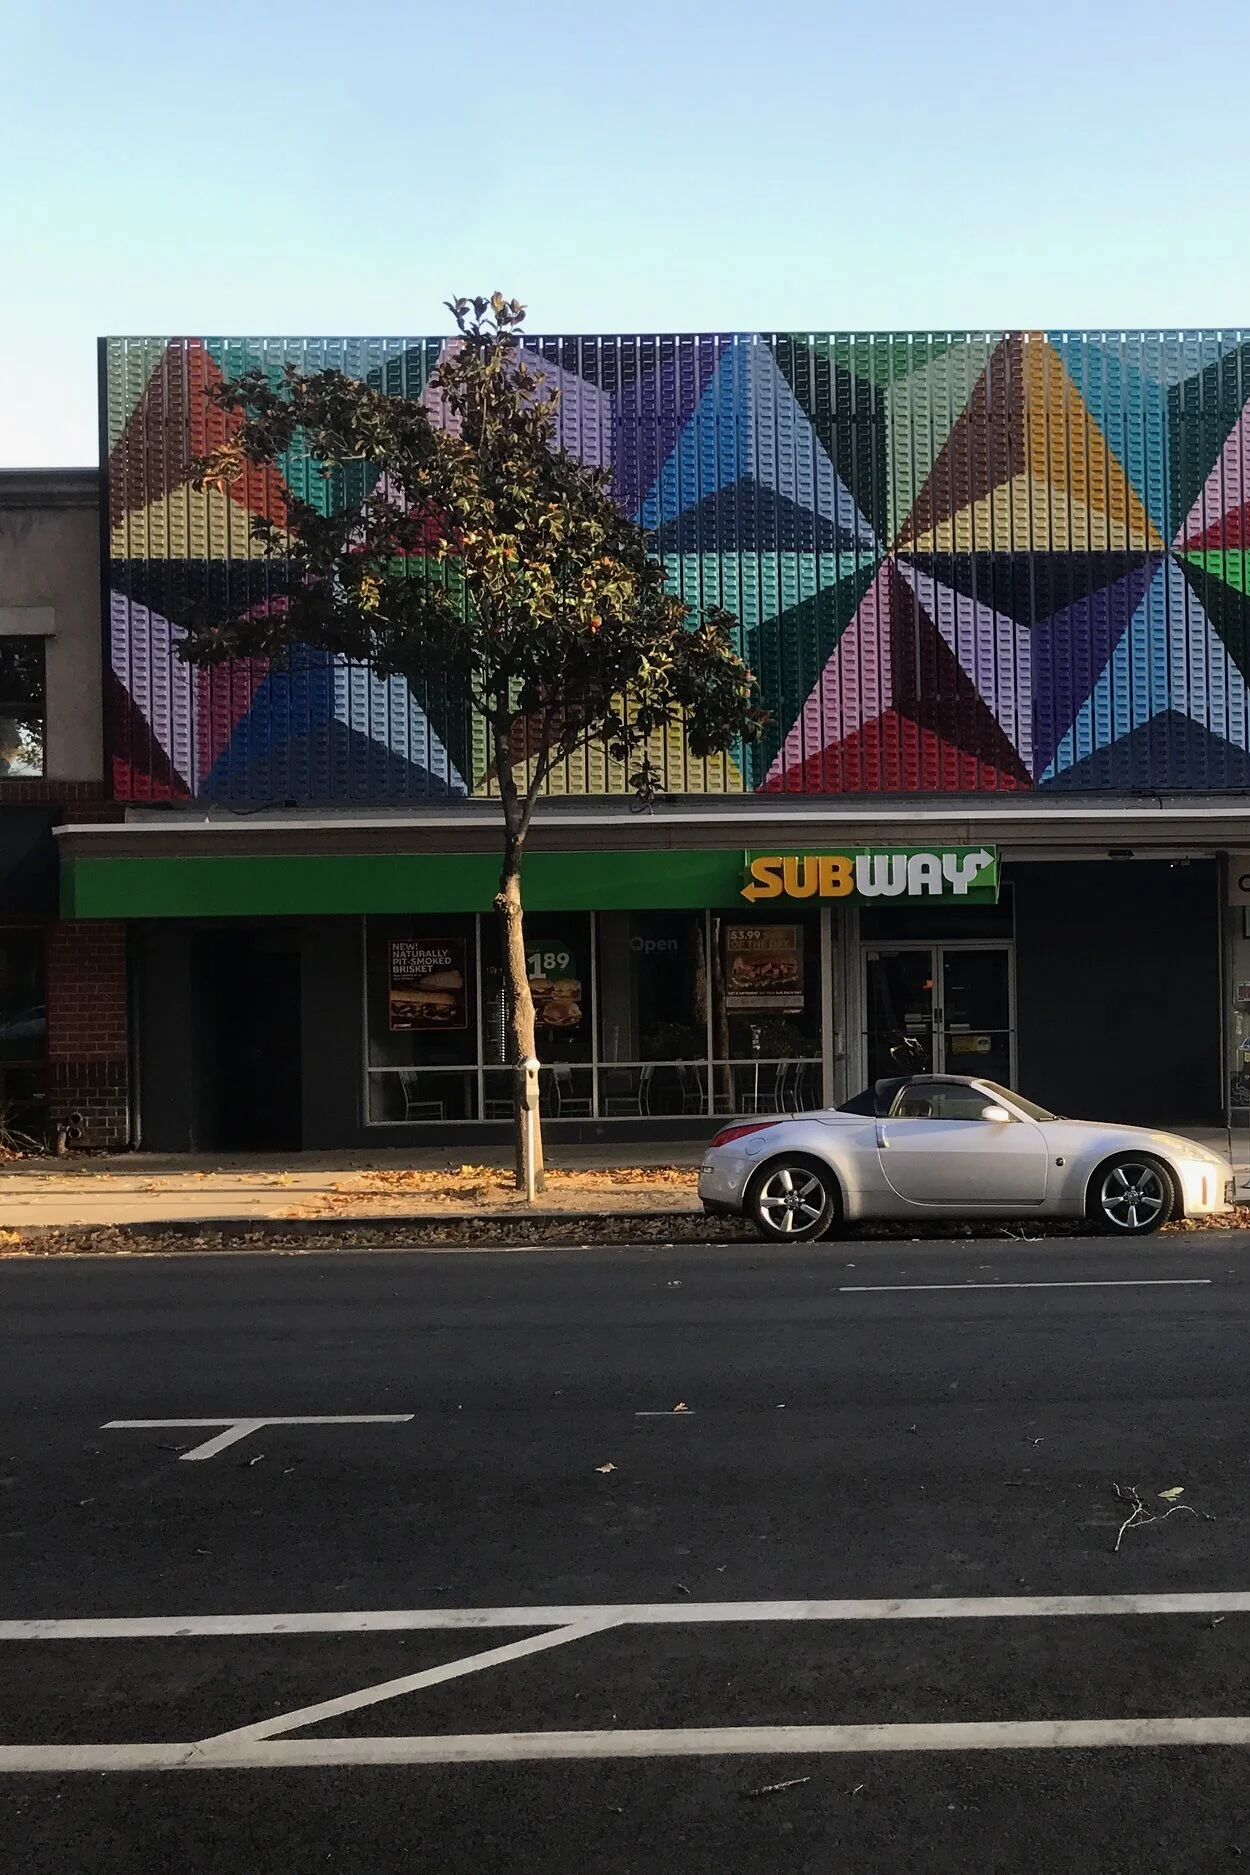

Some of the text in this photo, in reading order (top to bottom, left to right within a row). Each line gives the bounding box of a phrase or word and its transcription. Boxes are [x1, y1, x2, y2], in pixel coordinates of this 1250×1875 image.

[740, 848, 995, 903] SUBWAY
[392, 943, 419, 951] NEW!
[630, 936, 679, 954] Open
[392, 949, 449, 958] NATURALLY
[392, 957, 452, 966] PIT-SMOKED
[392, 965, 434, 973] BRISKET
